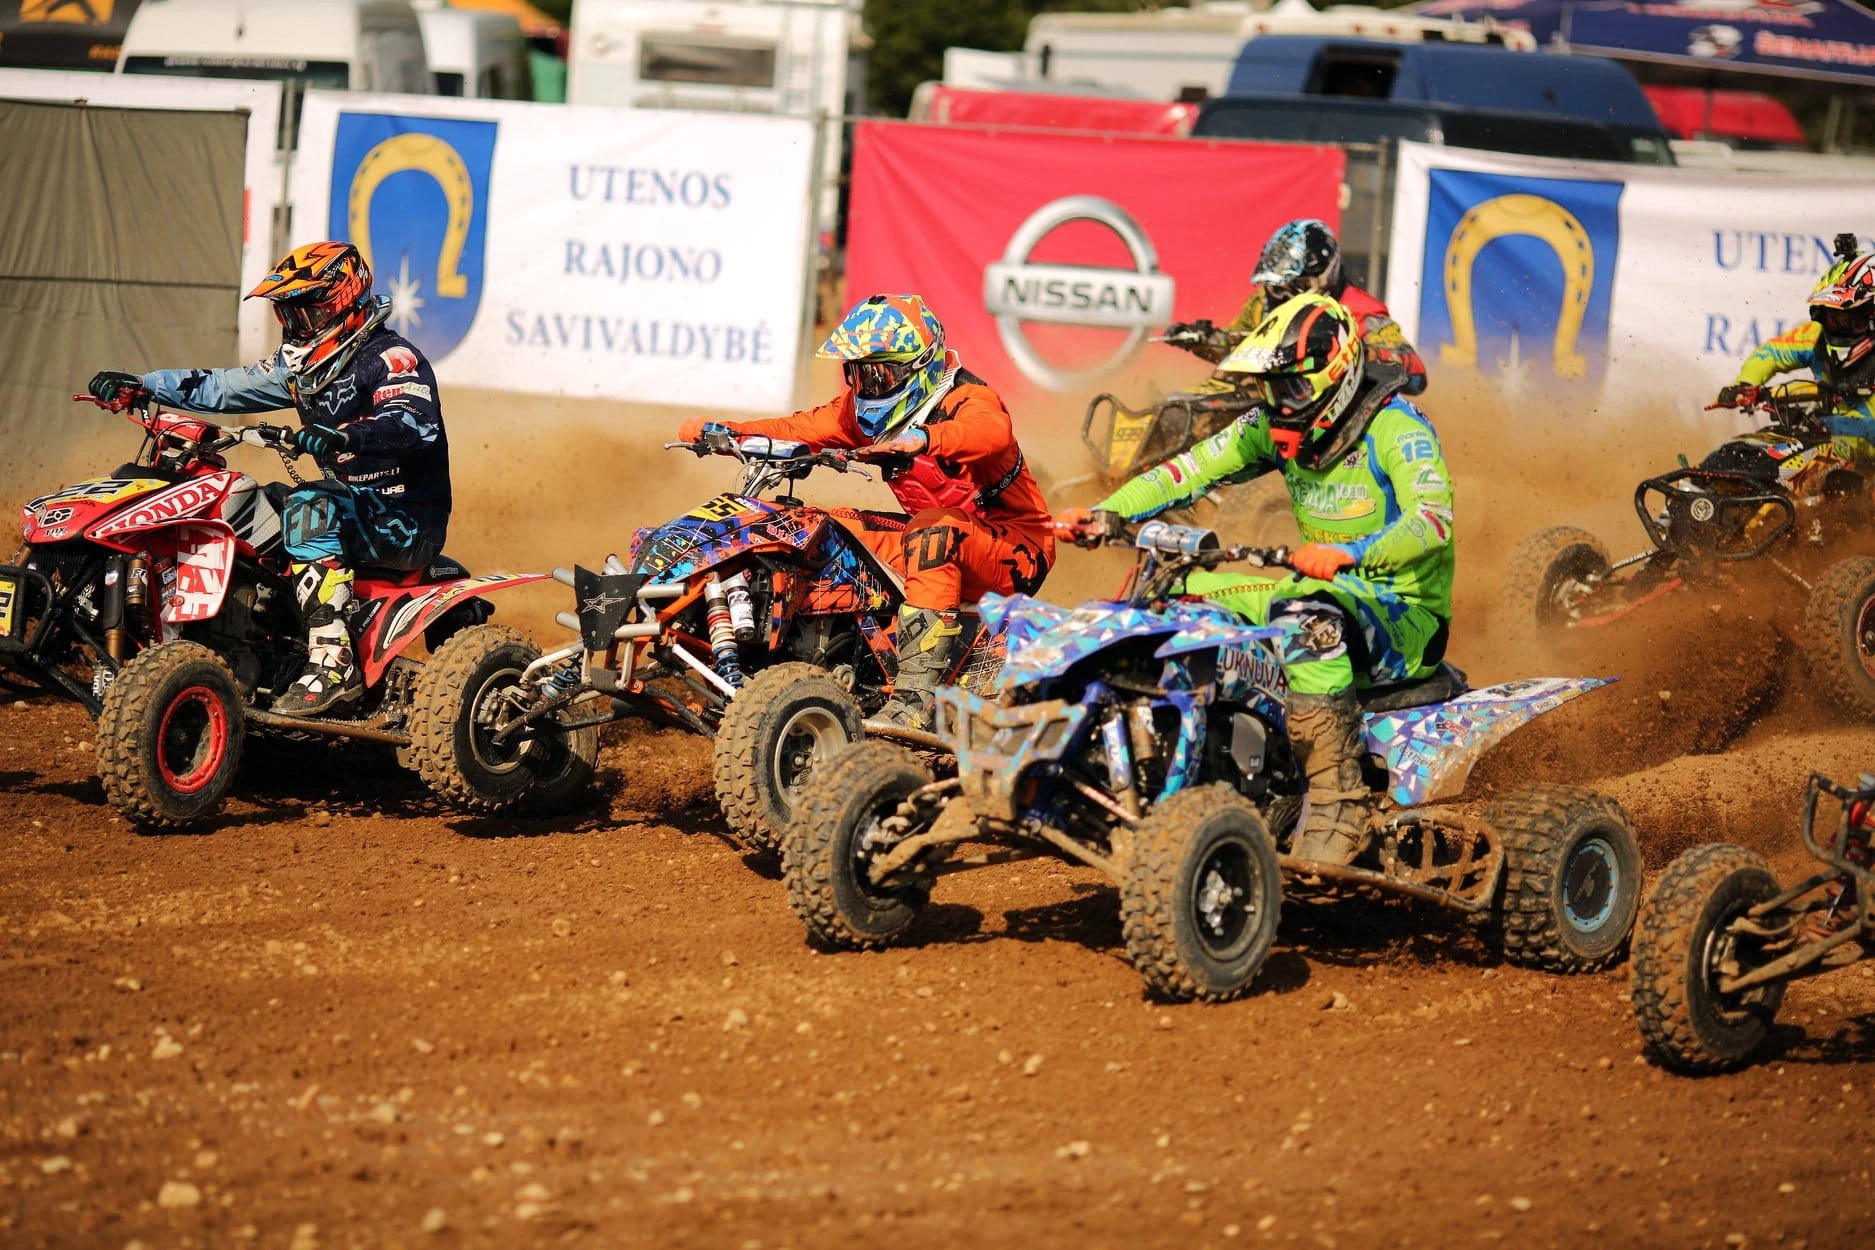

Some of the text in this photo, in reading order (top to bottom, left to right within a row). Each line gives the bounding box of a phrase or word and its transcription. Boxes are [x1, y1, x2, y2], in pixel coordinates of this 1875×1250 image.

[568, 164, 732, 209] UTENOS
[563, 239, 723, 286] RAJONO
[1712, 229, 1875, 276] UTEN
[1002, 276, 1154, 314] NISSAN
[505, 309, 773, 364] SAVIVALDYBĖ
[1401, 440, 1434, 463] 12
[101, 482, 223, 537] HONDA
[905, 525, 969, 573] FOX
